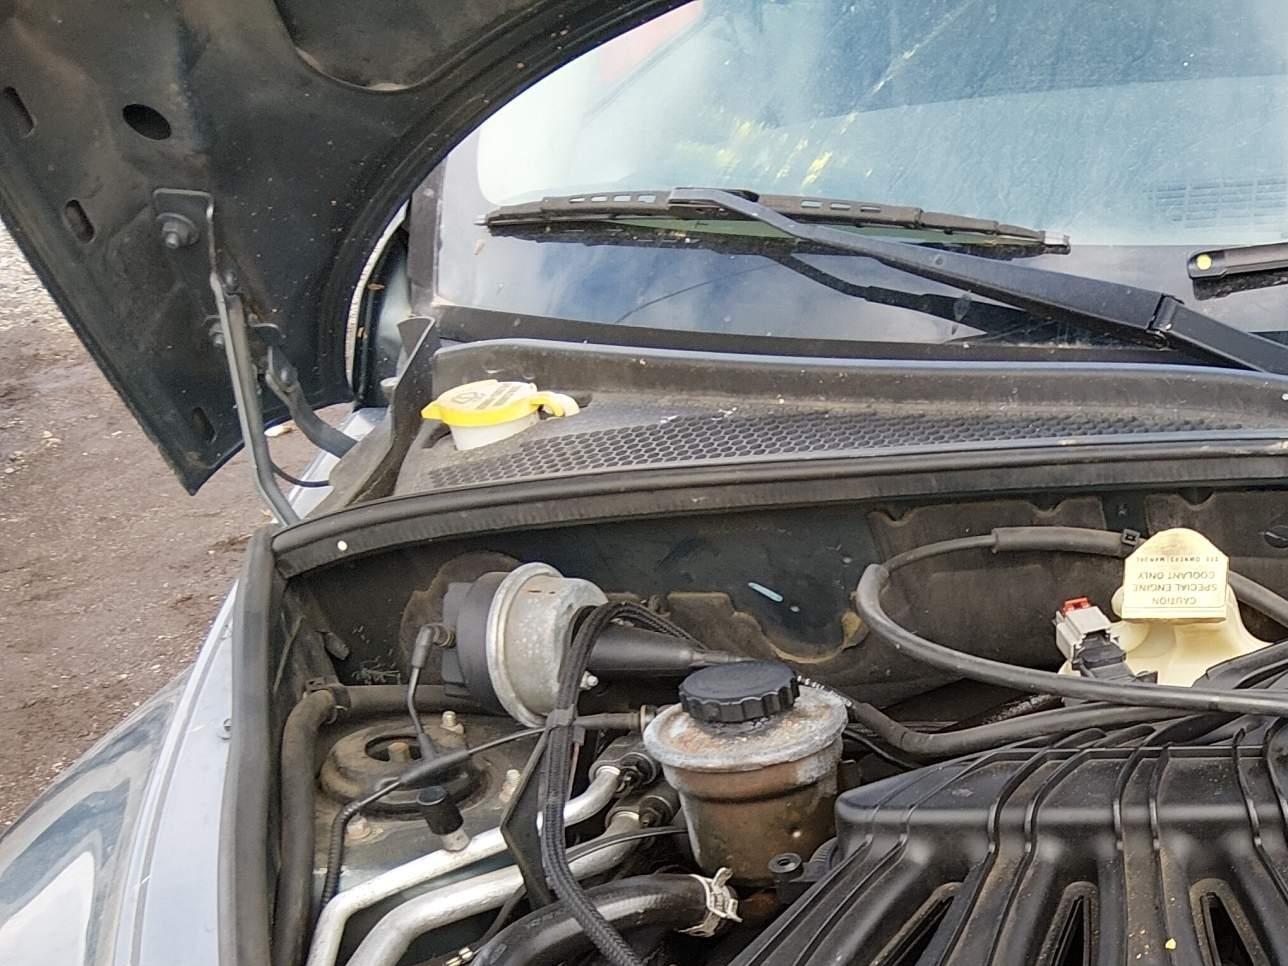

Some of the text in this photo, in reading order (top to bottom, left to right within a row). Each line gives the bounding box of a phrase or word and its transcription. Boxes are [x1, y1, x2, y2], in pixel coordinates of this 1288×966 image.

[1138, 571, 1216, 580] COOLANT ONLY
[1132, 583, 1217, 592] SPECIAL ENGINE
[1152, 597, 1197, 605] CAUTION
